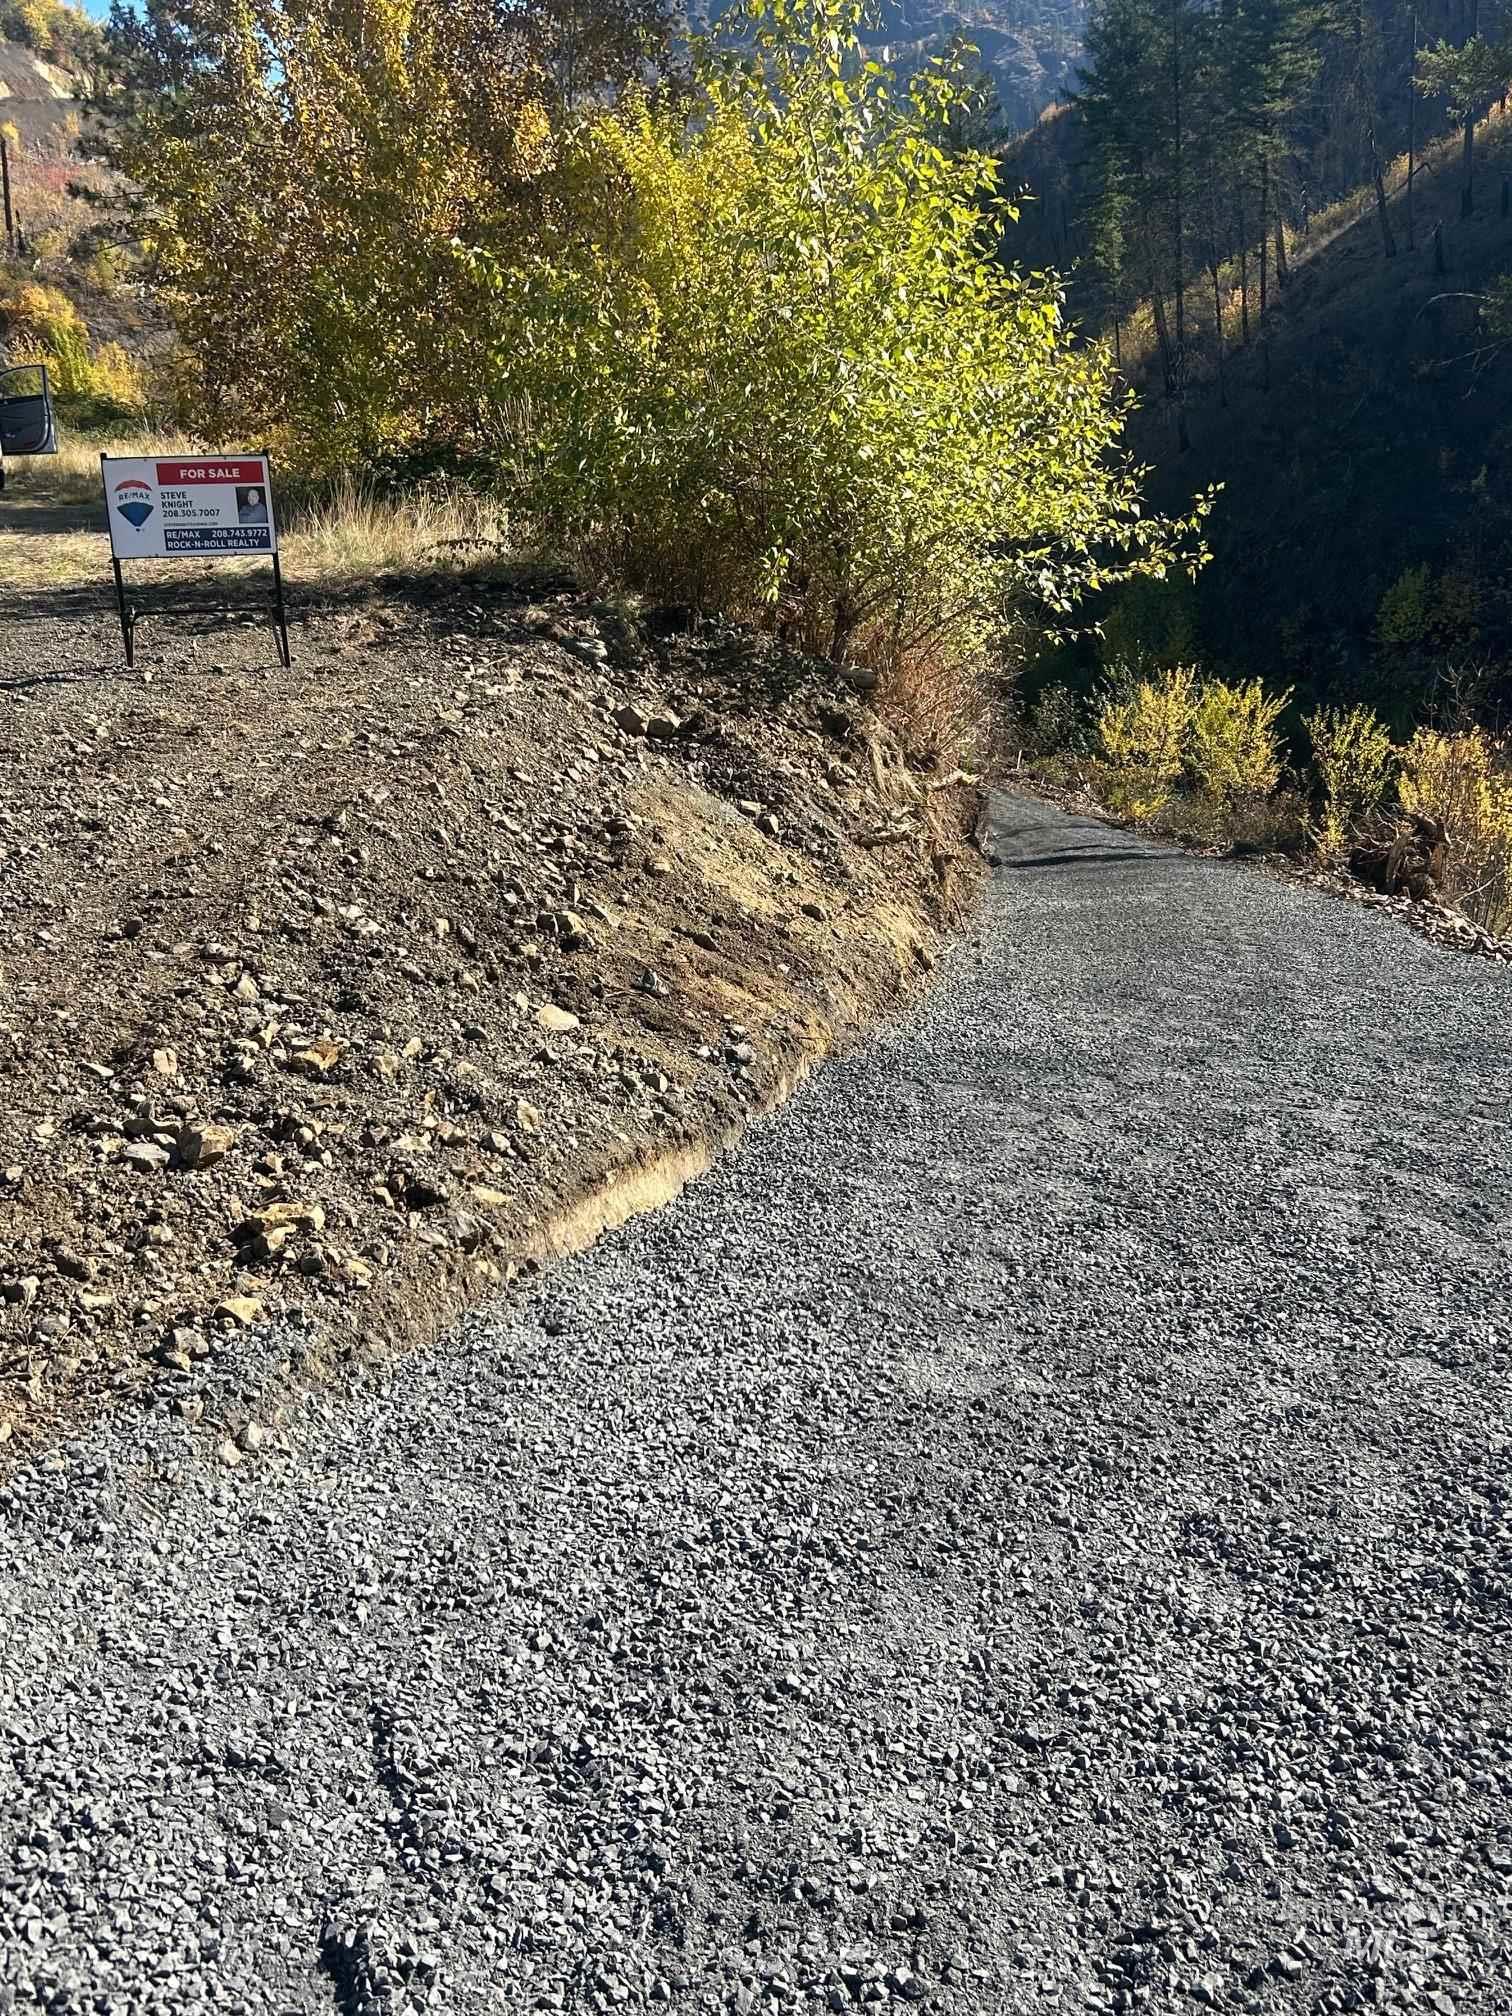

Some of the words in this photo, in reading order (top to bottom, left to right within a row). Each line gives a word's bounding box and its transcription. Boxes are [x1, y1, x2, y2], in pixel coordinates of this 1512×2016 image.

[180, 468, 205, 479] FOR
[208, 467, 240, 479] SALE
[118, 491, 150, 501] RE/MAX
[160, 491, 187, 500] STEVE
[161, 501, 192, 509] KNIGHT
[163, 509, 220, 518] 208.305.7007
[166, 530, 200, 539] RE/MAX
[212, 529, 267, 538] 208.743.9772
[167, 540, 226, 549] ROCK-N-ROLL
[227, 539, 259, 547] REALTY
